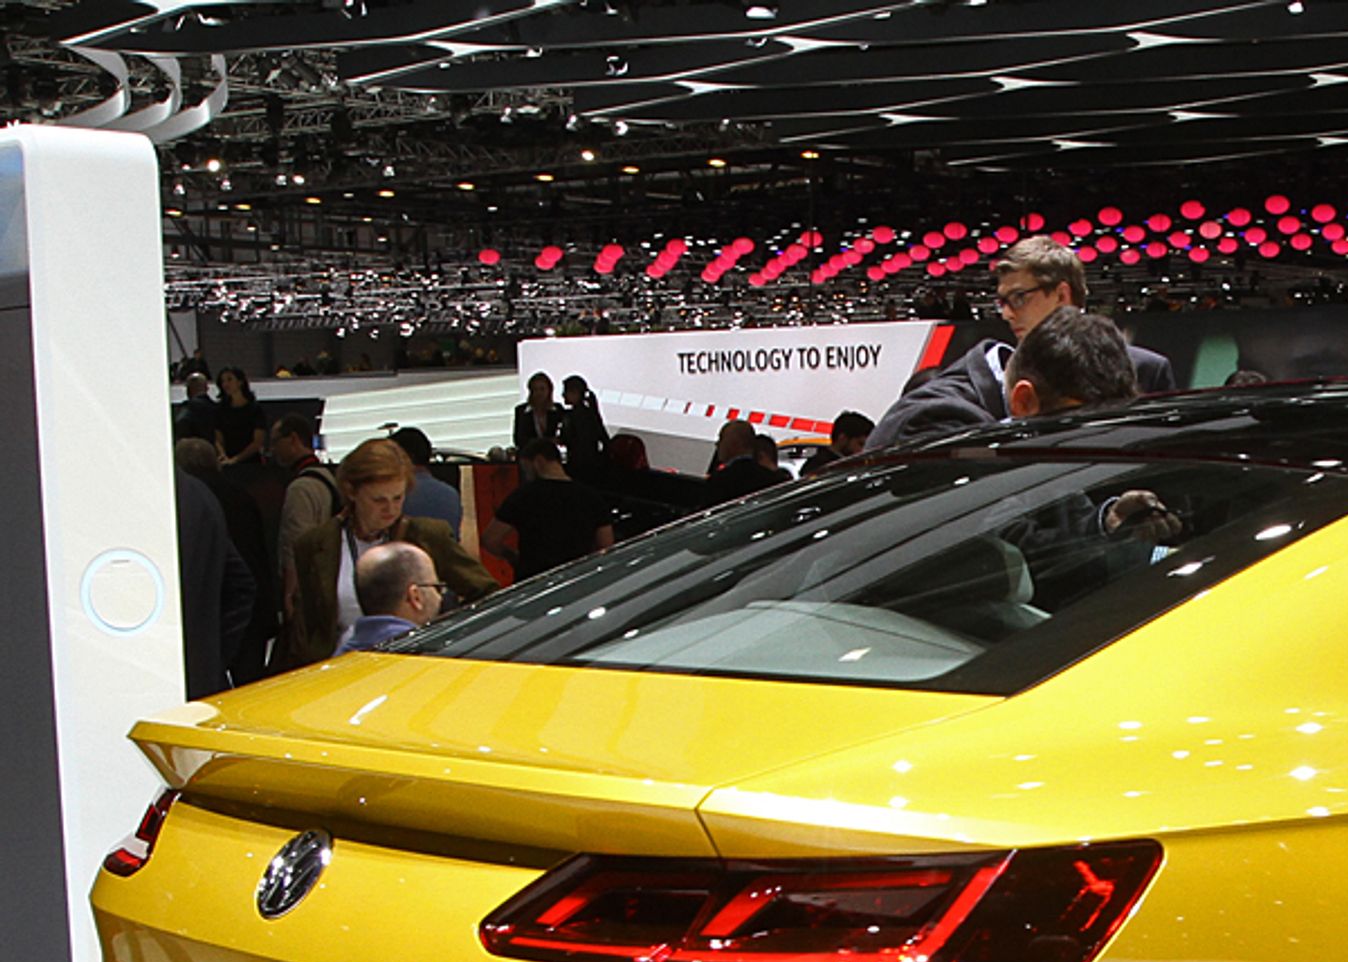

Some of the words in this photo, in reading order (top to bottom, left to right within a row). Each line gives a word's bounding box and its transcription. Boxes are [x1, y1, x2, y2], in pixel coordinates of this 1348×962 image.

[677, 349, 793, 374] TECHNOLOGY
[798, 347, 821, 370] TO
[826, 344, 882, 370] ENJOY
